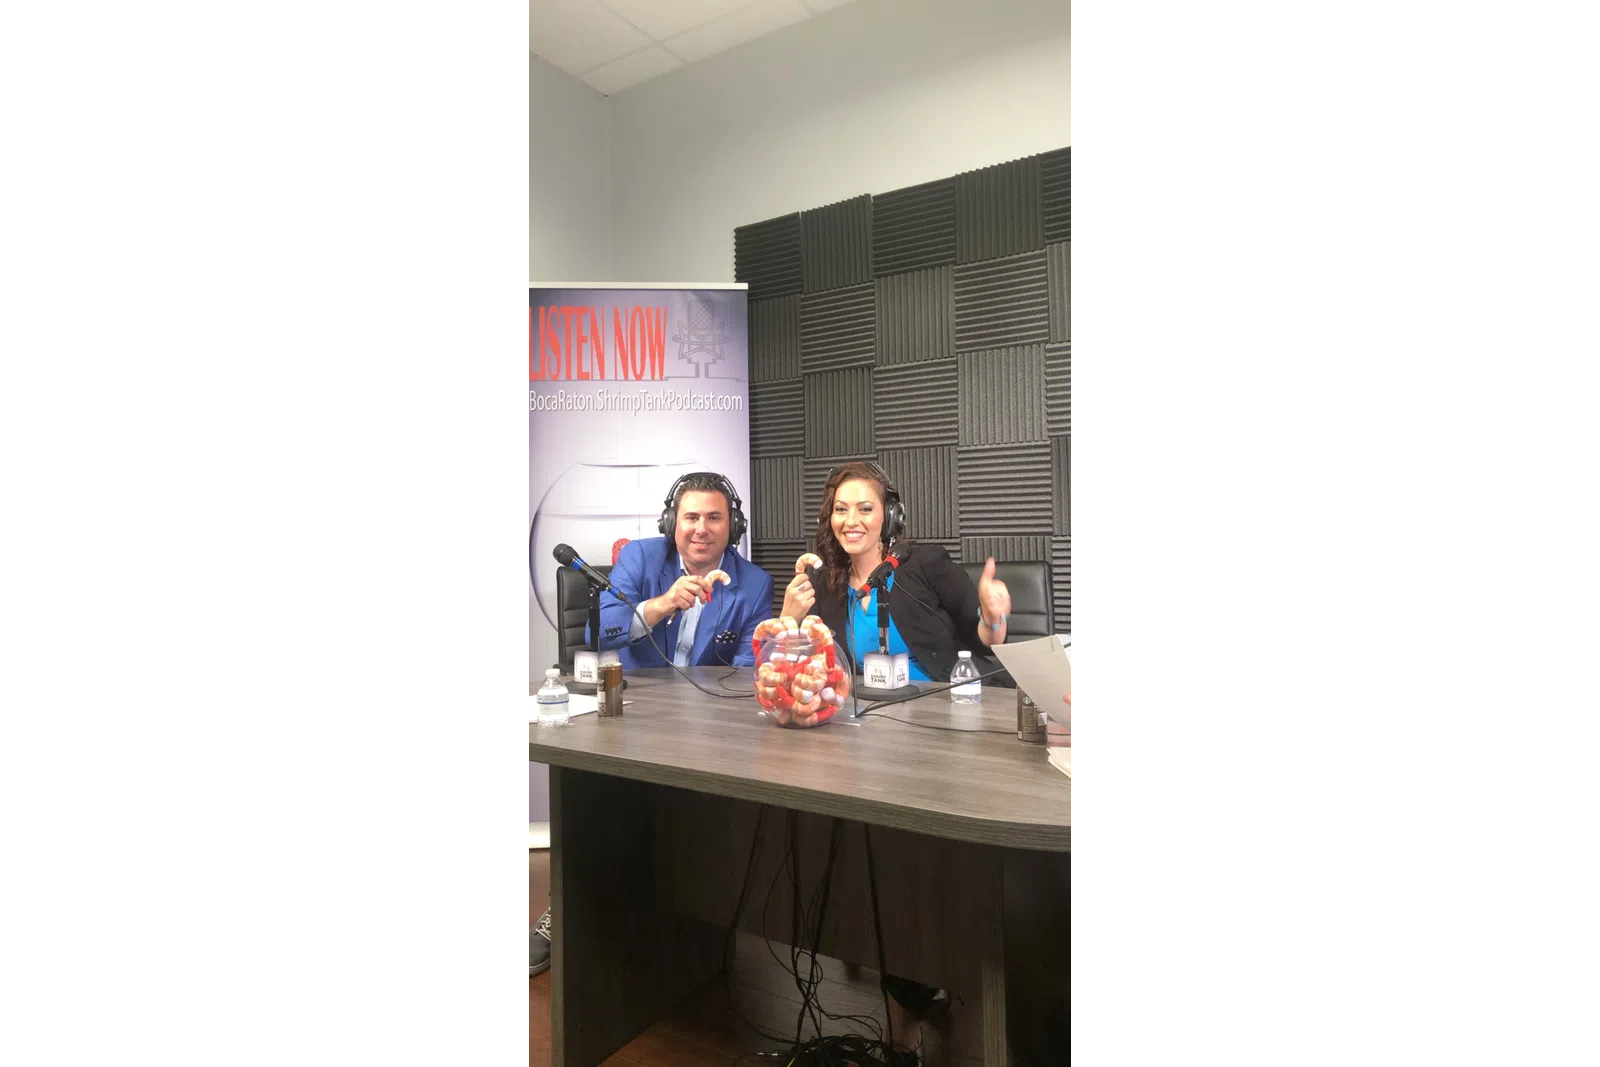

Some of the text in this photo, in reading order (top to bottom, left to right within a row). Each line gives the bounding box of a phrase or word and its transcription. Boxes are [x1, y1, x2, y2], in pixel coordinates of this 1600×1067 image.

[528, 305, 668, 381] LISTEN NOW
[529, 390, 744, 416] BocaRaton.ShrimpTankPodcast.com
